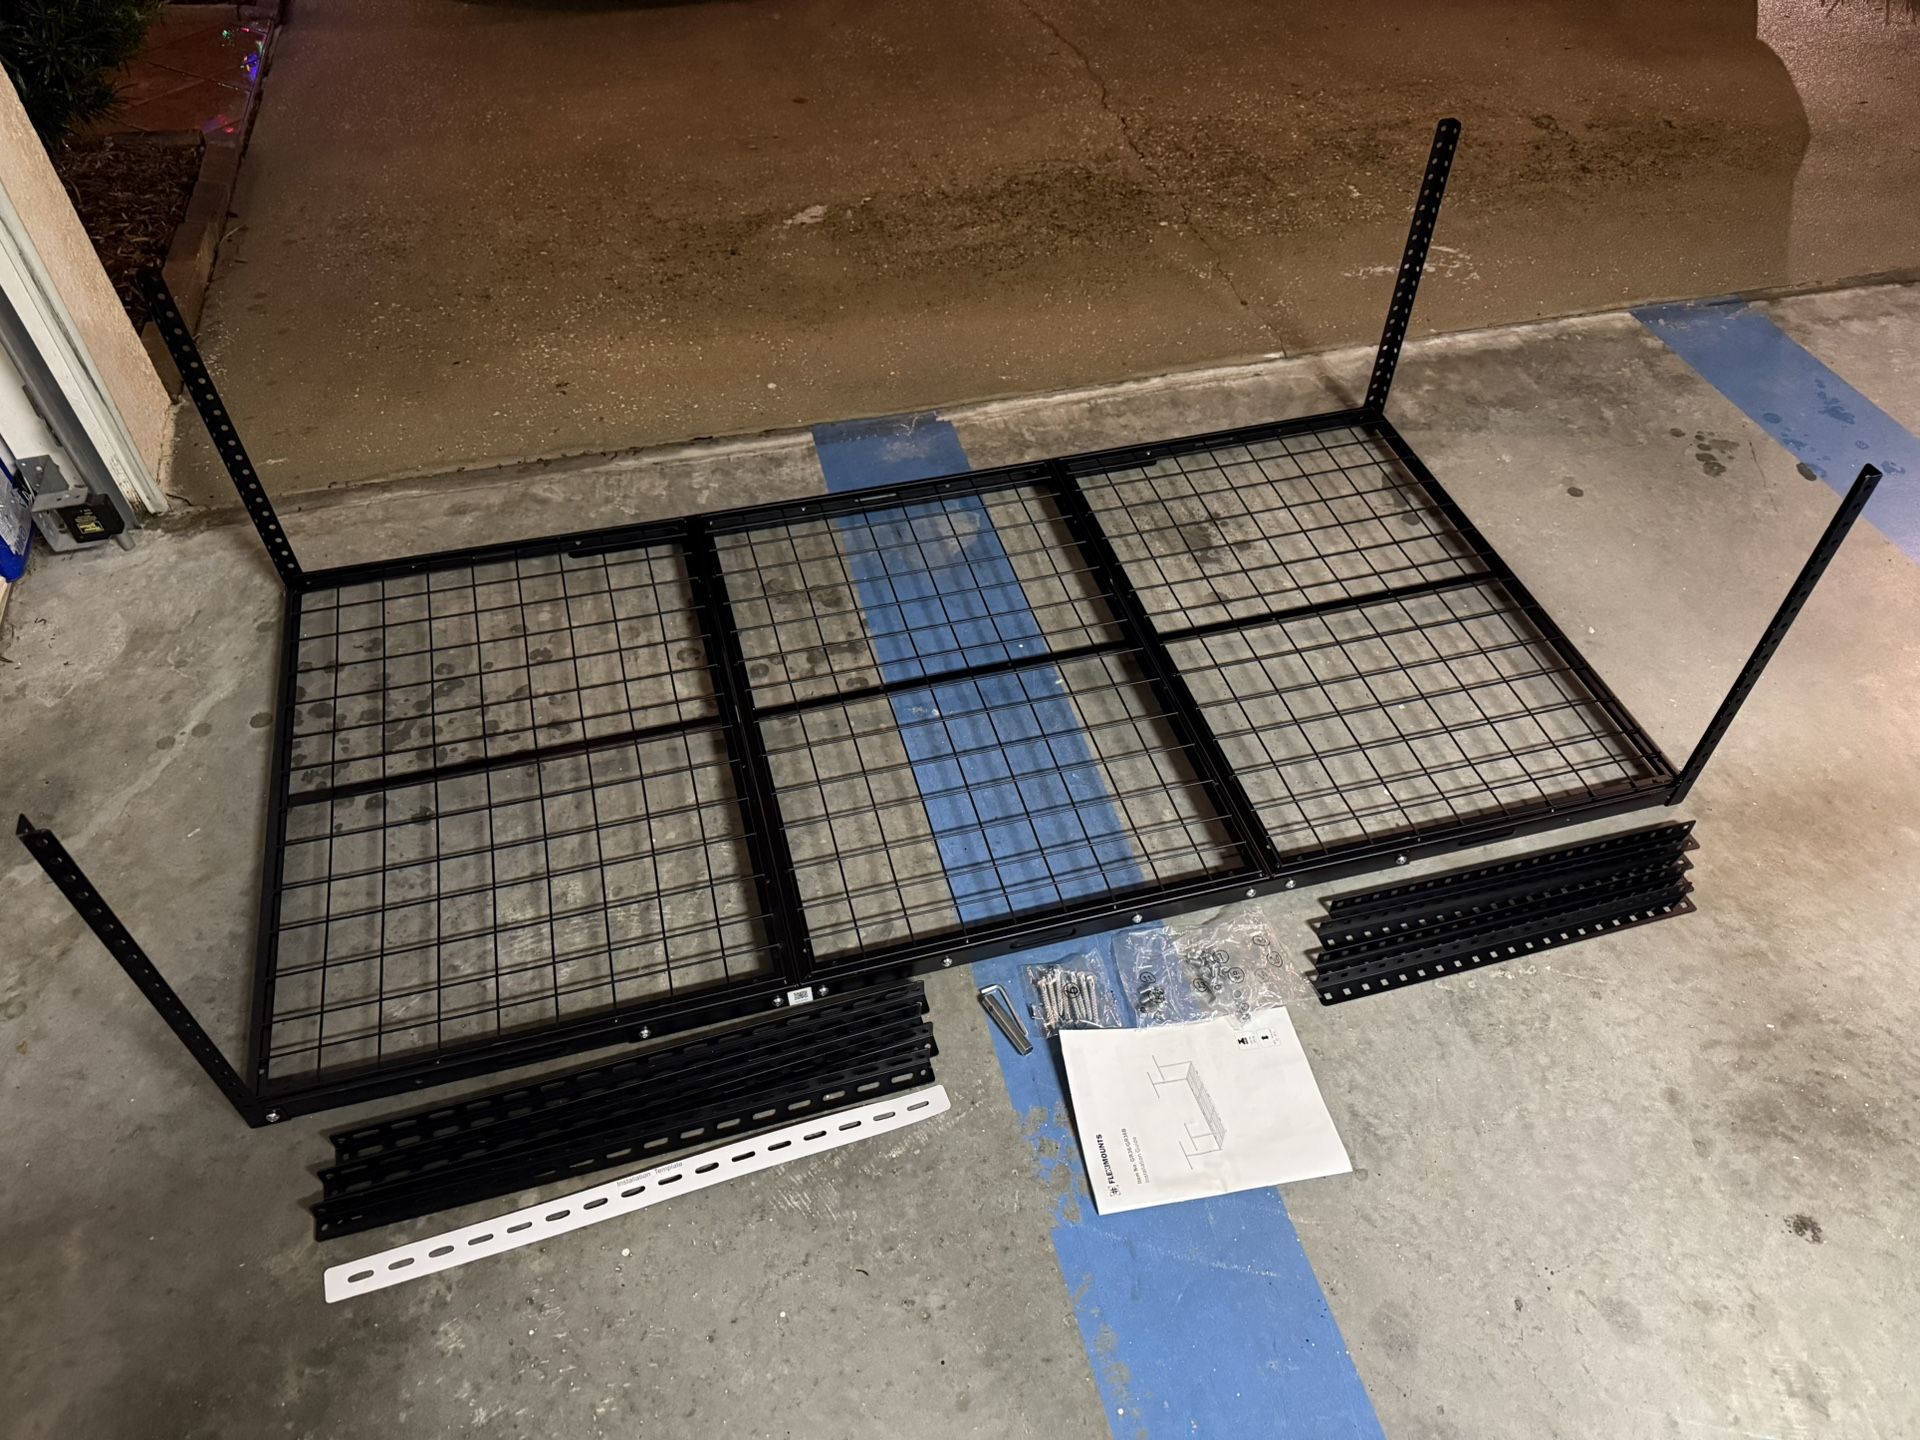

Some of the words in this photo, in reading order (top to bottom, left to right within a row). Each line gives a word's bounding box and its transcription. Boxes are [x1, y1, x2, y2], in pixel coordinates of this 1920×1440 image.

[1132, 1136, 1140, 1153] Guide
[1096, 1134, 1115, 1184] FLEXIMOUNTS
[1138, 1153, 1149, 1183] Installation
[617, 1172, 651, 1187] Installation
[654, 1162, 683, 1175] Template
